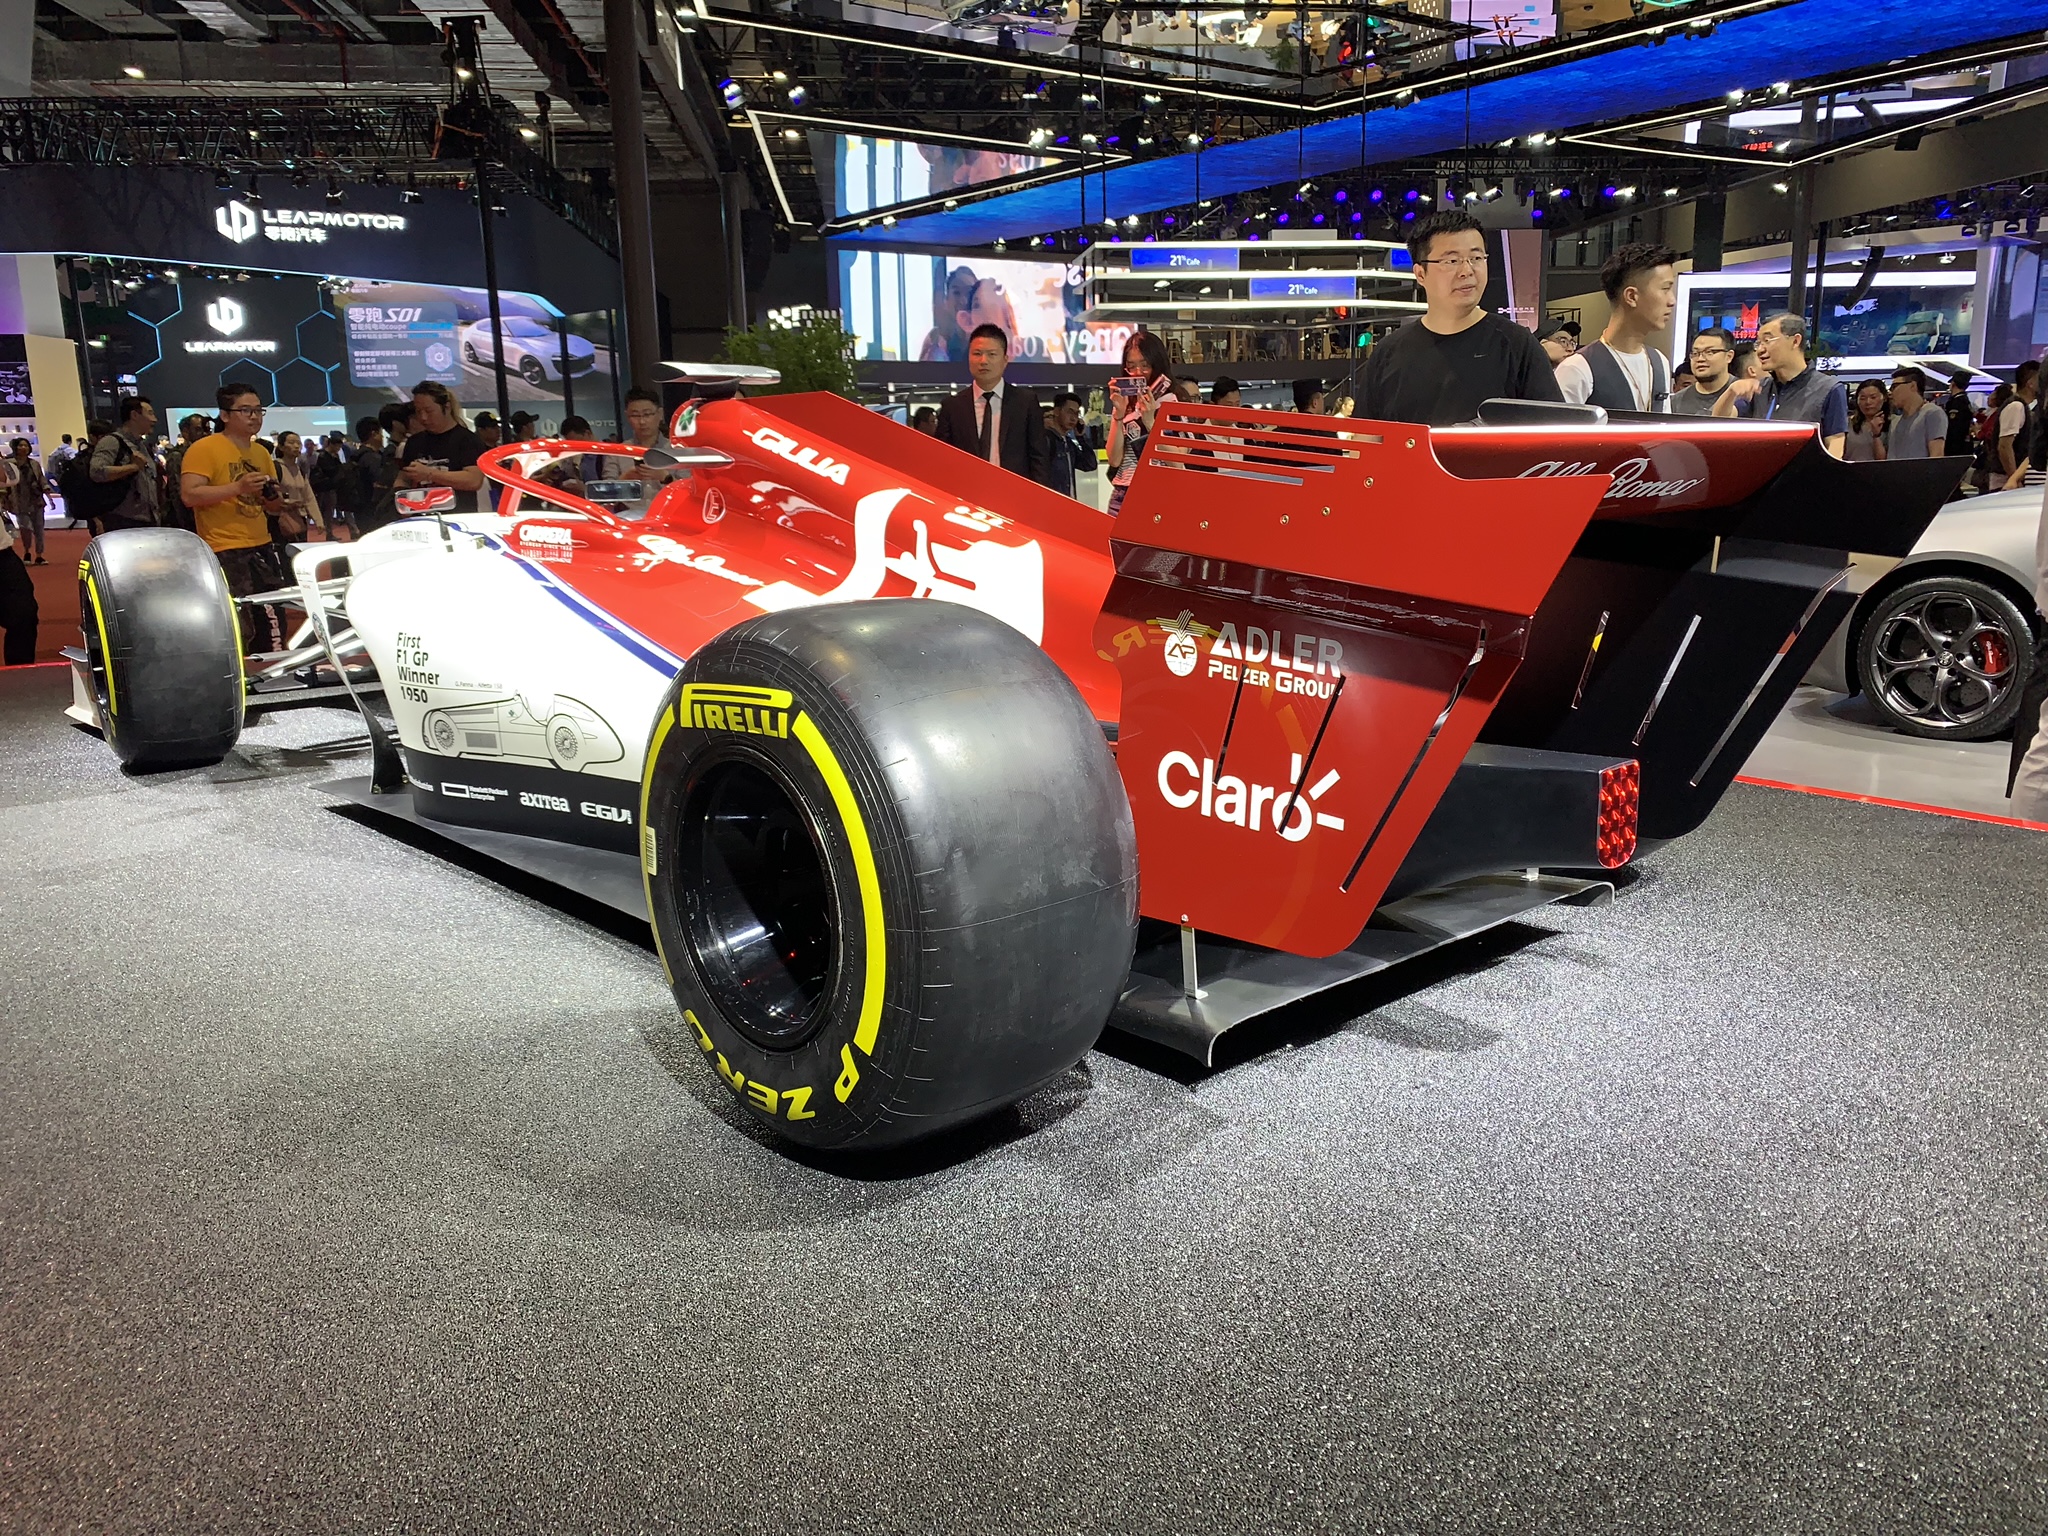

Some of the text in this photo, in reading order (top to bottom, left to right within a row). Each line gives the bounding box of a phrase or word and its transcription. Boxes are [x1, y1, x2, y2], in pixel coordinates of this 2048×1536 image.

[262, 209, 407, 231] LEAPMOTOR
[264, 225, 327, 244] 零跑汽车
[348, 307, 382, 323] 零跑
[183, 340, 276, 353] LEAPMOTOR
[751, 427, 851, 486] GIULIA
[519, 524, 572, 546] CARRERA
[396, 632, 421, 650] First
[1210, 621, 1344, 679] ADLER
[396, 649, 429, 667] F1 GP
[397, 665, 440, 687] Winner
[400, 685, 429, 704] 1950
[680, 683, 793, 739] PIRELLI
[1157, 750, 1313, 842] Claro
